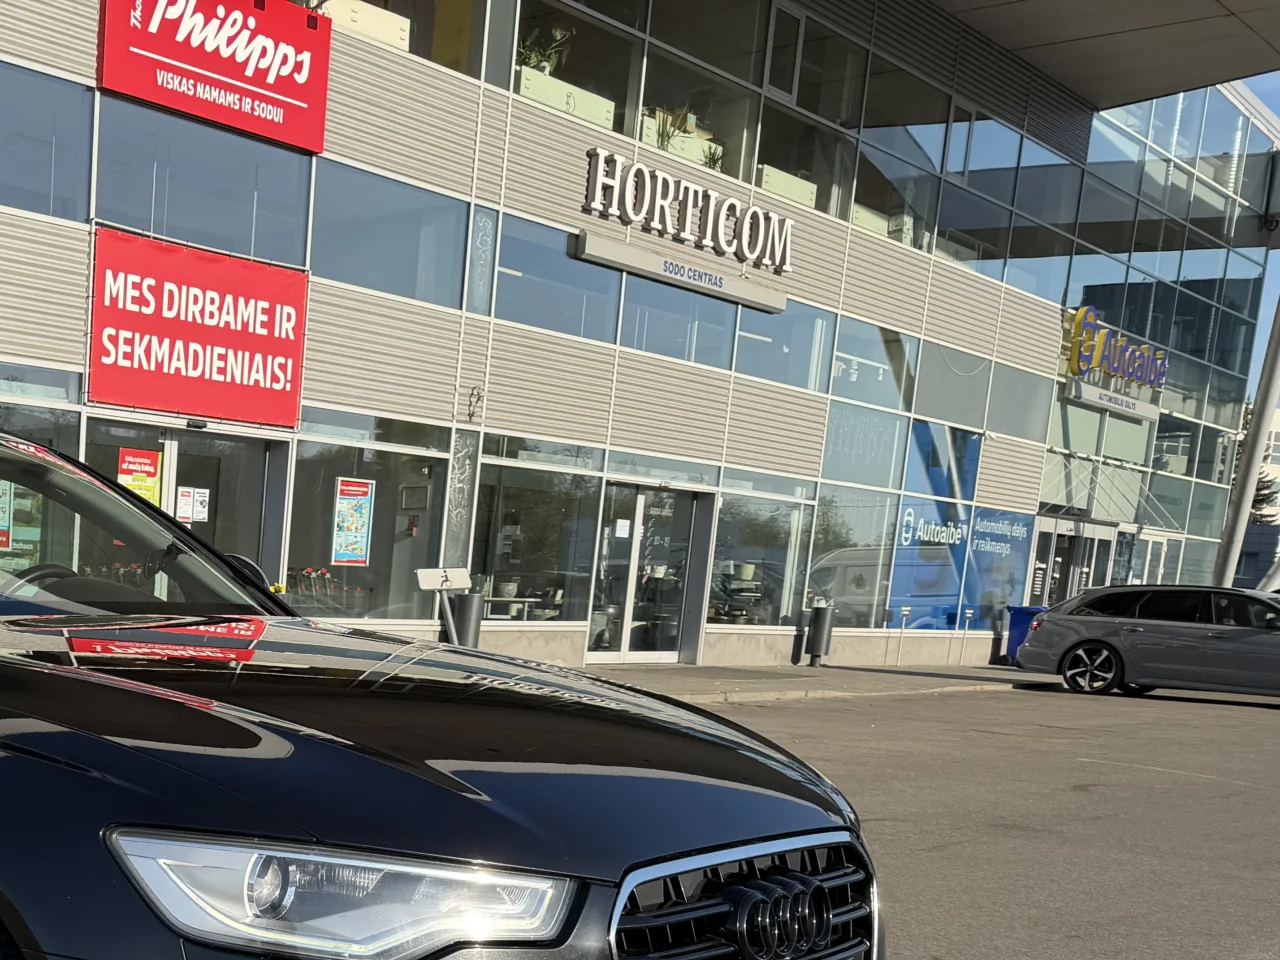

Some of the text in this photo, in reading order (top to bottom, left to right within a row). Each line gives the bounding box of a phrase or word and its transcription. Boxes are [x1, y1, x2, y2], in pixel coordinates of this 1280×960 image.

[130, 0, 143, 30] Tho
[148, 0, 311, 84] Philipps
[156, 69, 283, 124] VISKAS NAMAMS IR SODUI
[590, 147, 795, 272] HORTICOM
[663, 260, 724, 289] SODO CENTRAS
[104, 268, 297, 340] MES DIRBAME IR
[101, 326, 293, 392] SEKMADIENIAIS!
[915, 518, 962, 545] Autoaibė
[978, 537, 1011, 557] reikmenys
[1011, 522, 1027, 540] dalys
